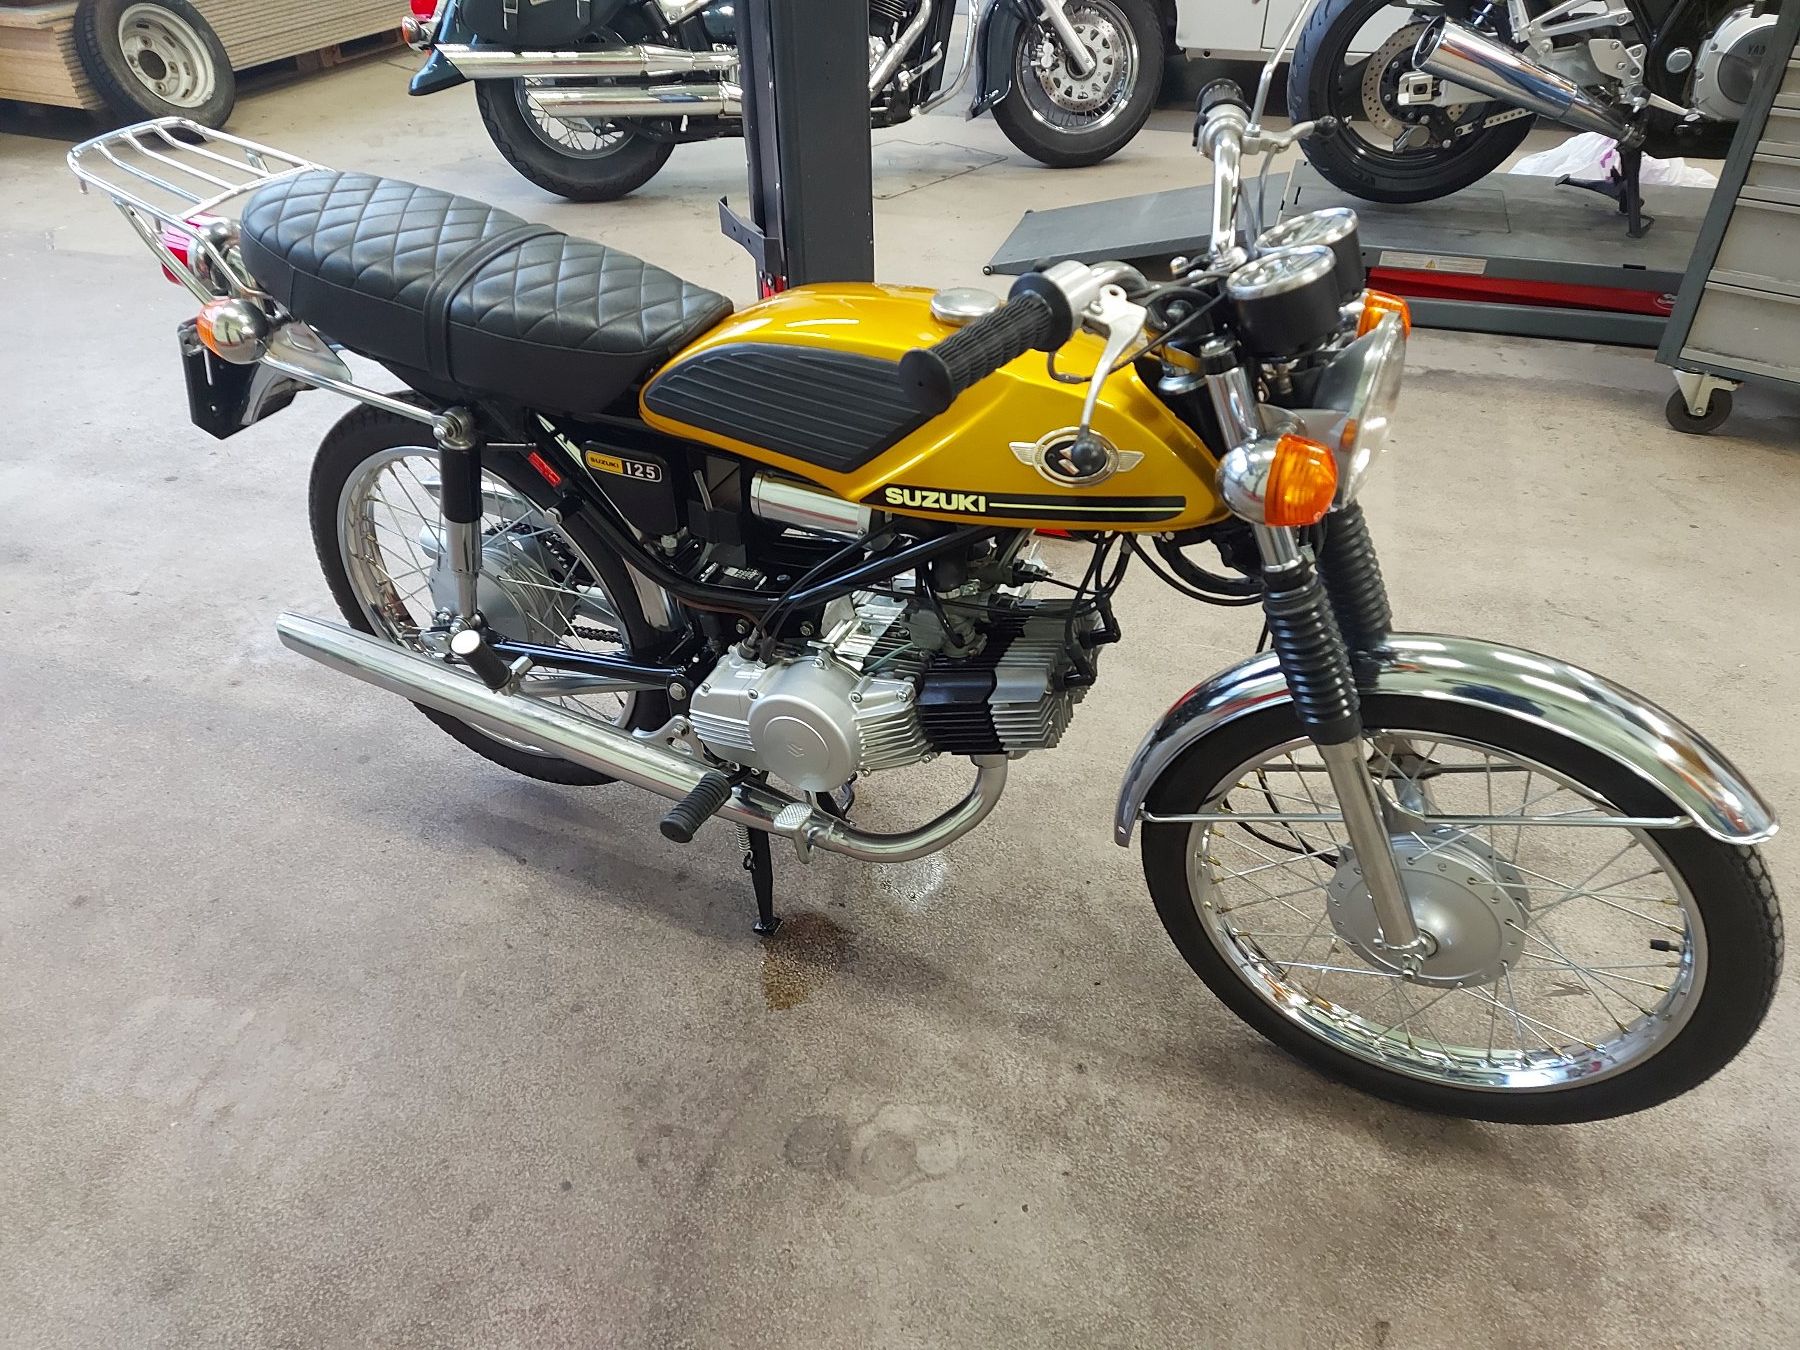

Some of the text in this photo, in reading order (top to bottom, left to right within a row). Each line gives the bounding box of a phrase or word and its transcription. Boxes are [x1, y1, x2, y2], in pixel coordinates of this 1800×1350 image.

[590, 457, 656, 479] SUZUKI 125
[885, 487, 986, 512] SUZUKI
